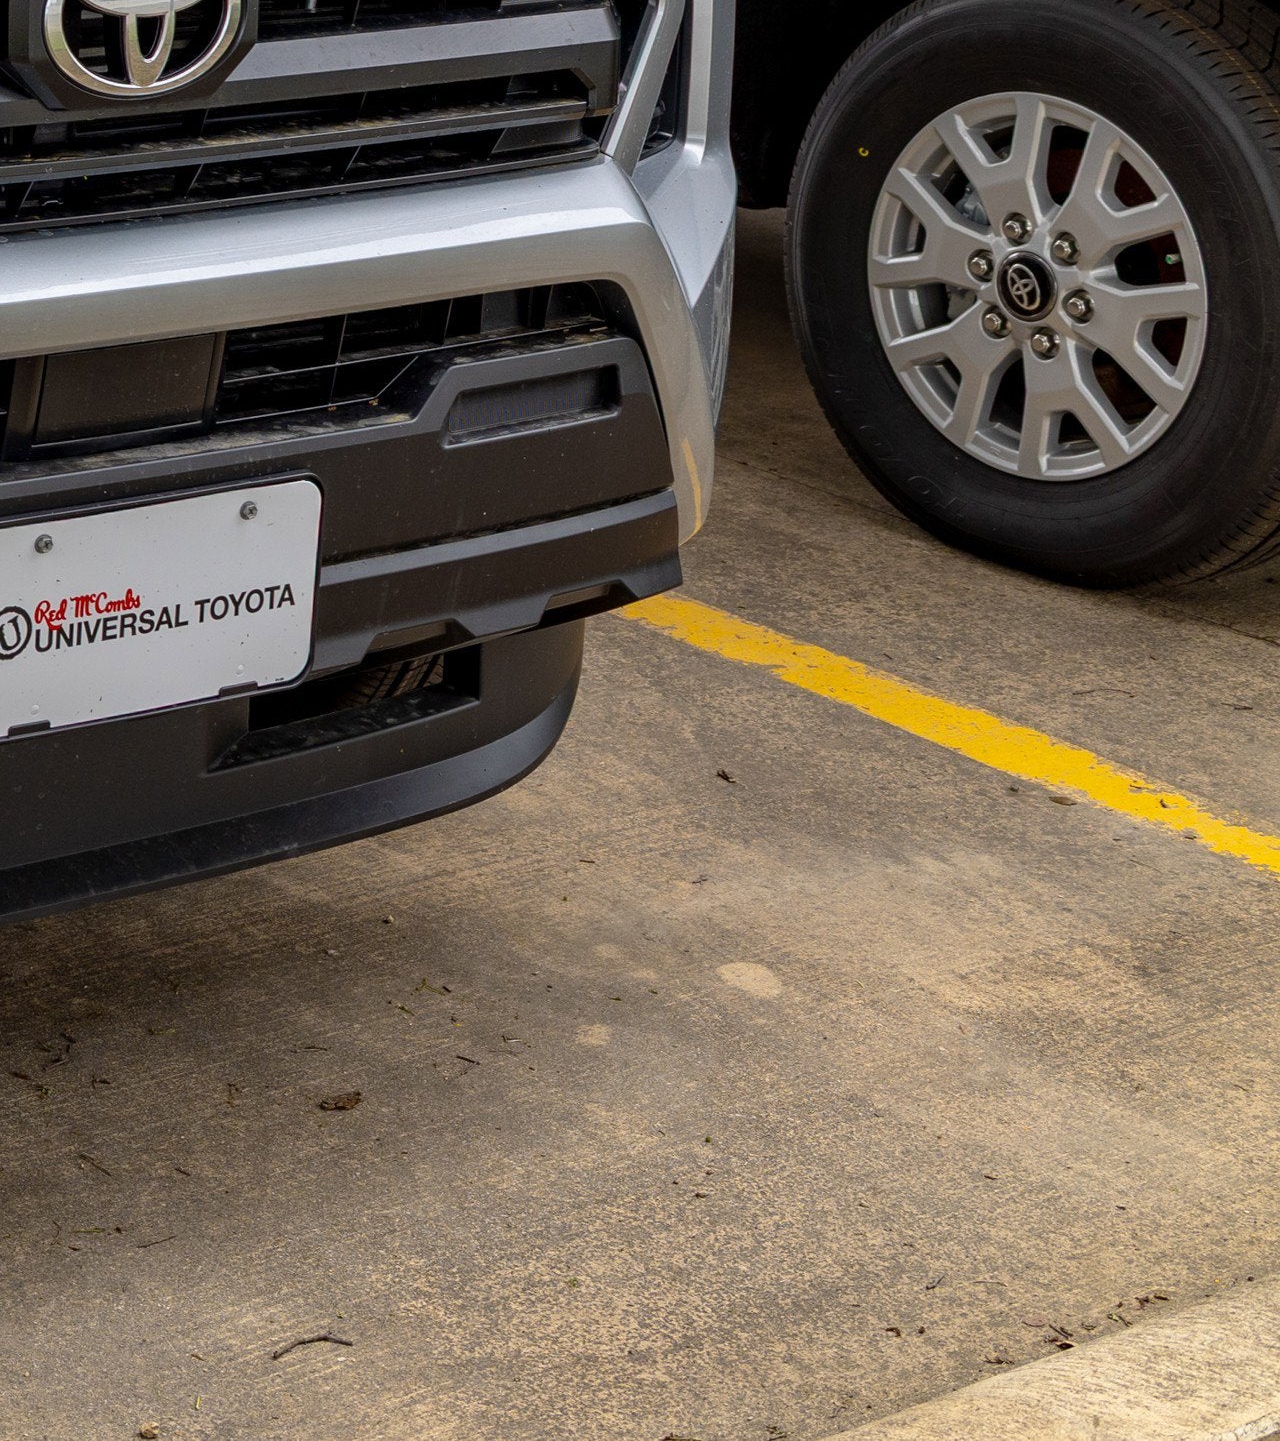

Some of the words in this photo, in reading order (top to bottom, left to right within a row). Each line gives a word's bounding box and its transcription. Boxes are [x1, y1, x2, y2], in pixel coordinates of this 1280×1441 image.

[34, 598, 68, 631] Red
[70, 588, 141, 617] McCombs
[34, 604, 189, 653] UNIVERSAL
[194, 583, 296, 624] TOYOTA
